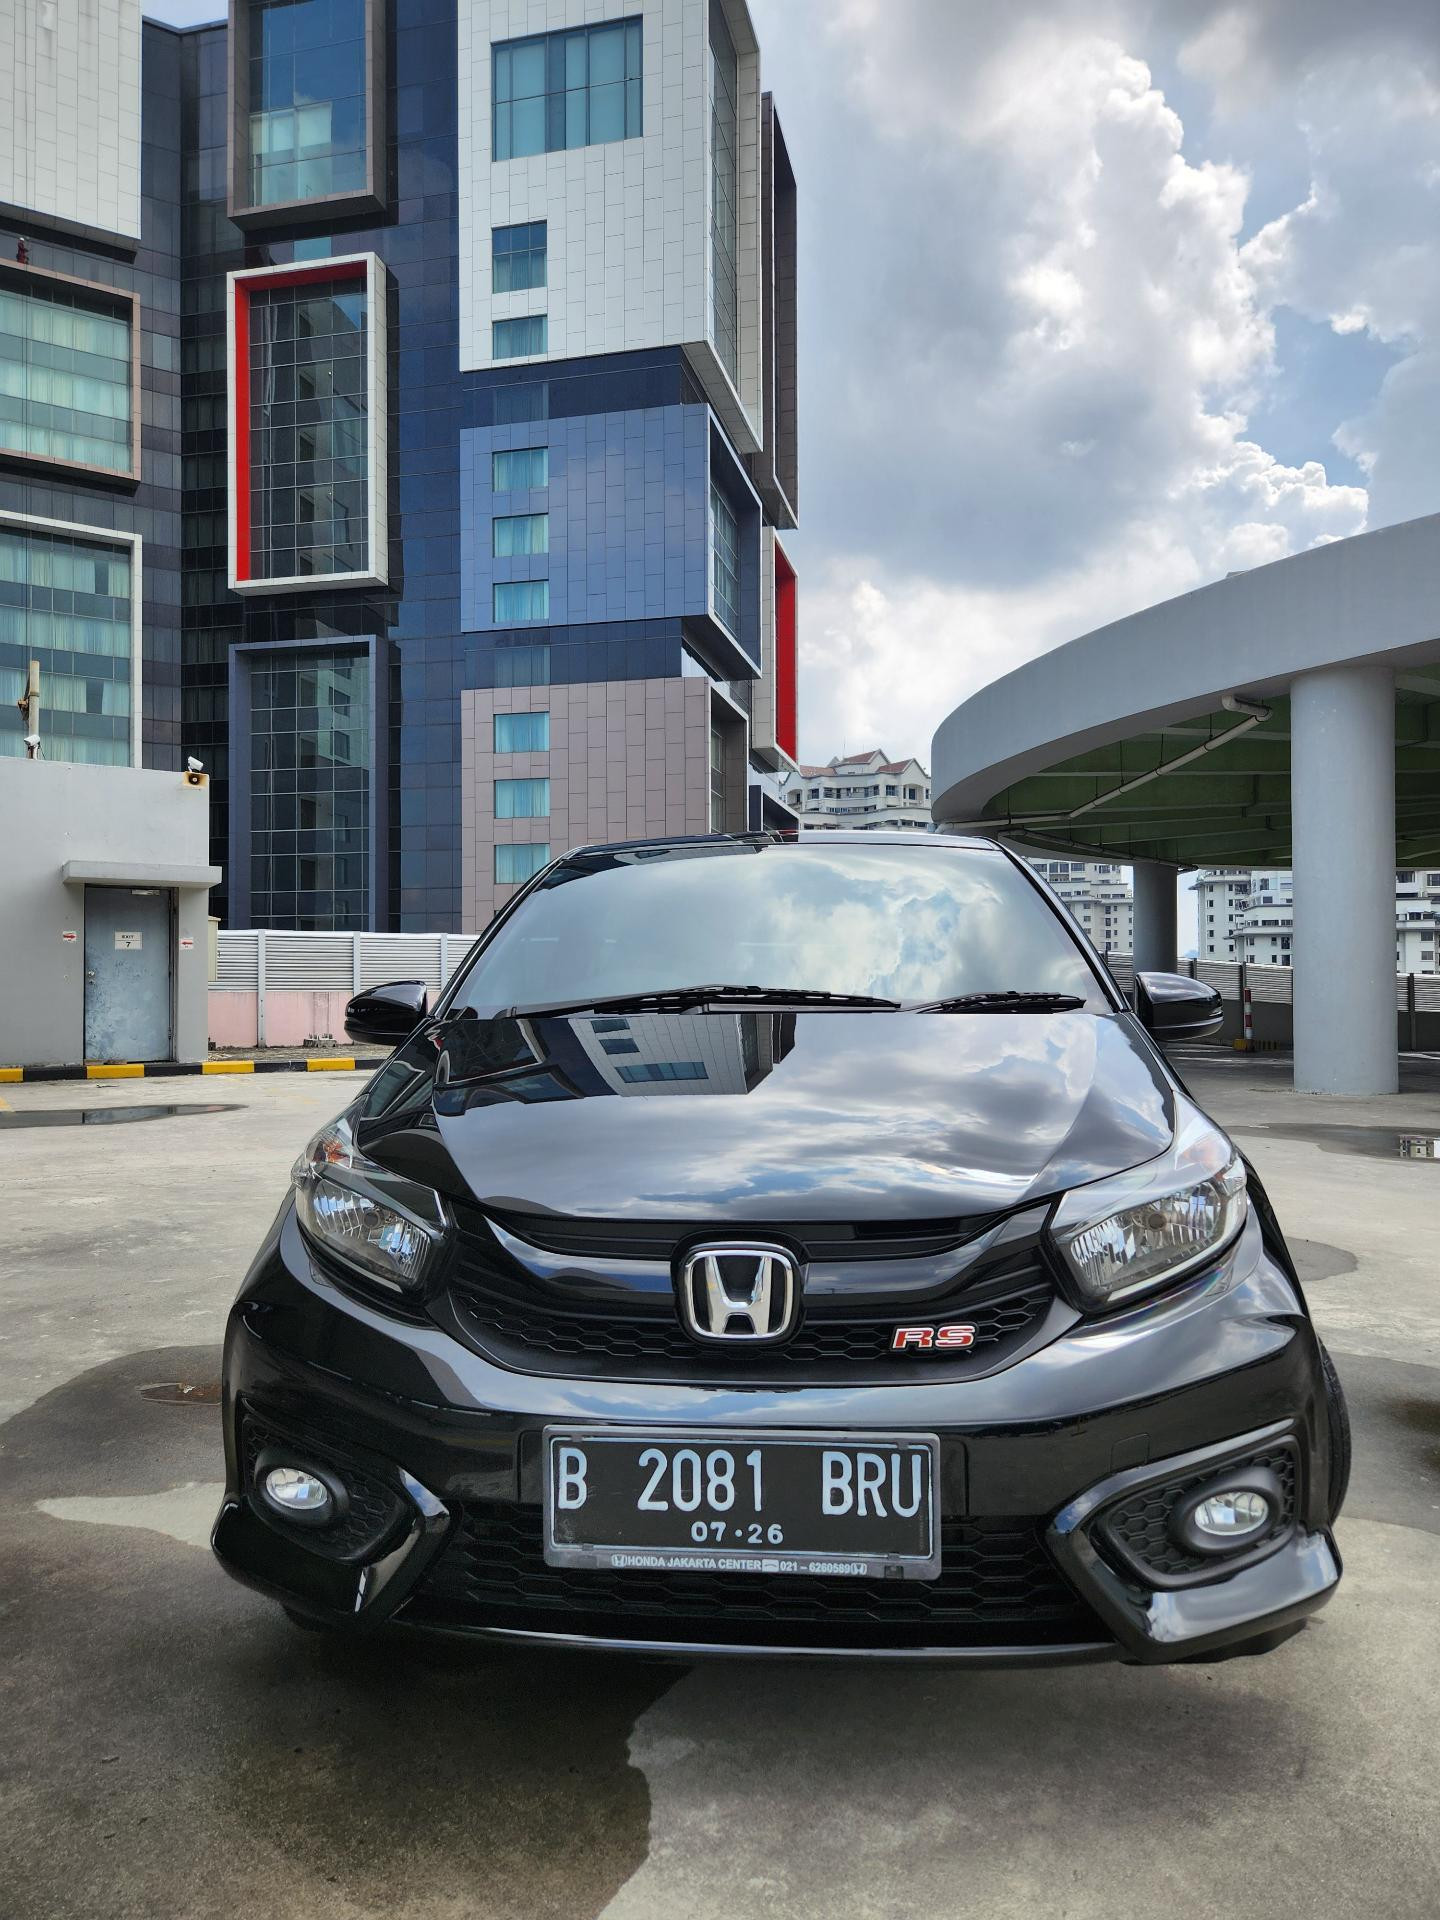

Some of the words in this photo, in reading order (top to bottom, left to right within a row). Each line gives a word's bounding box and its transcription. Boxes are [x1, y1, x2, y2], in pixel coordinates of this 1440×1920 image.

[892, 1325, 976, 1349] RS
[558, 1447, 588, 1509] B
[637, 1448, 763, 1512] 2081
[821, 1451, 922, 1518] BRU
[626, 1556, 666, 1567] HONDA
[667, 1556, 716, 1569] JAKARTA
[718, 1558, 762, 1570] CENTER
[780, 1561, 798, 1572] 021
